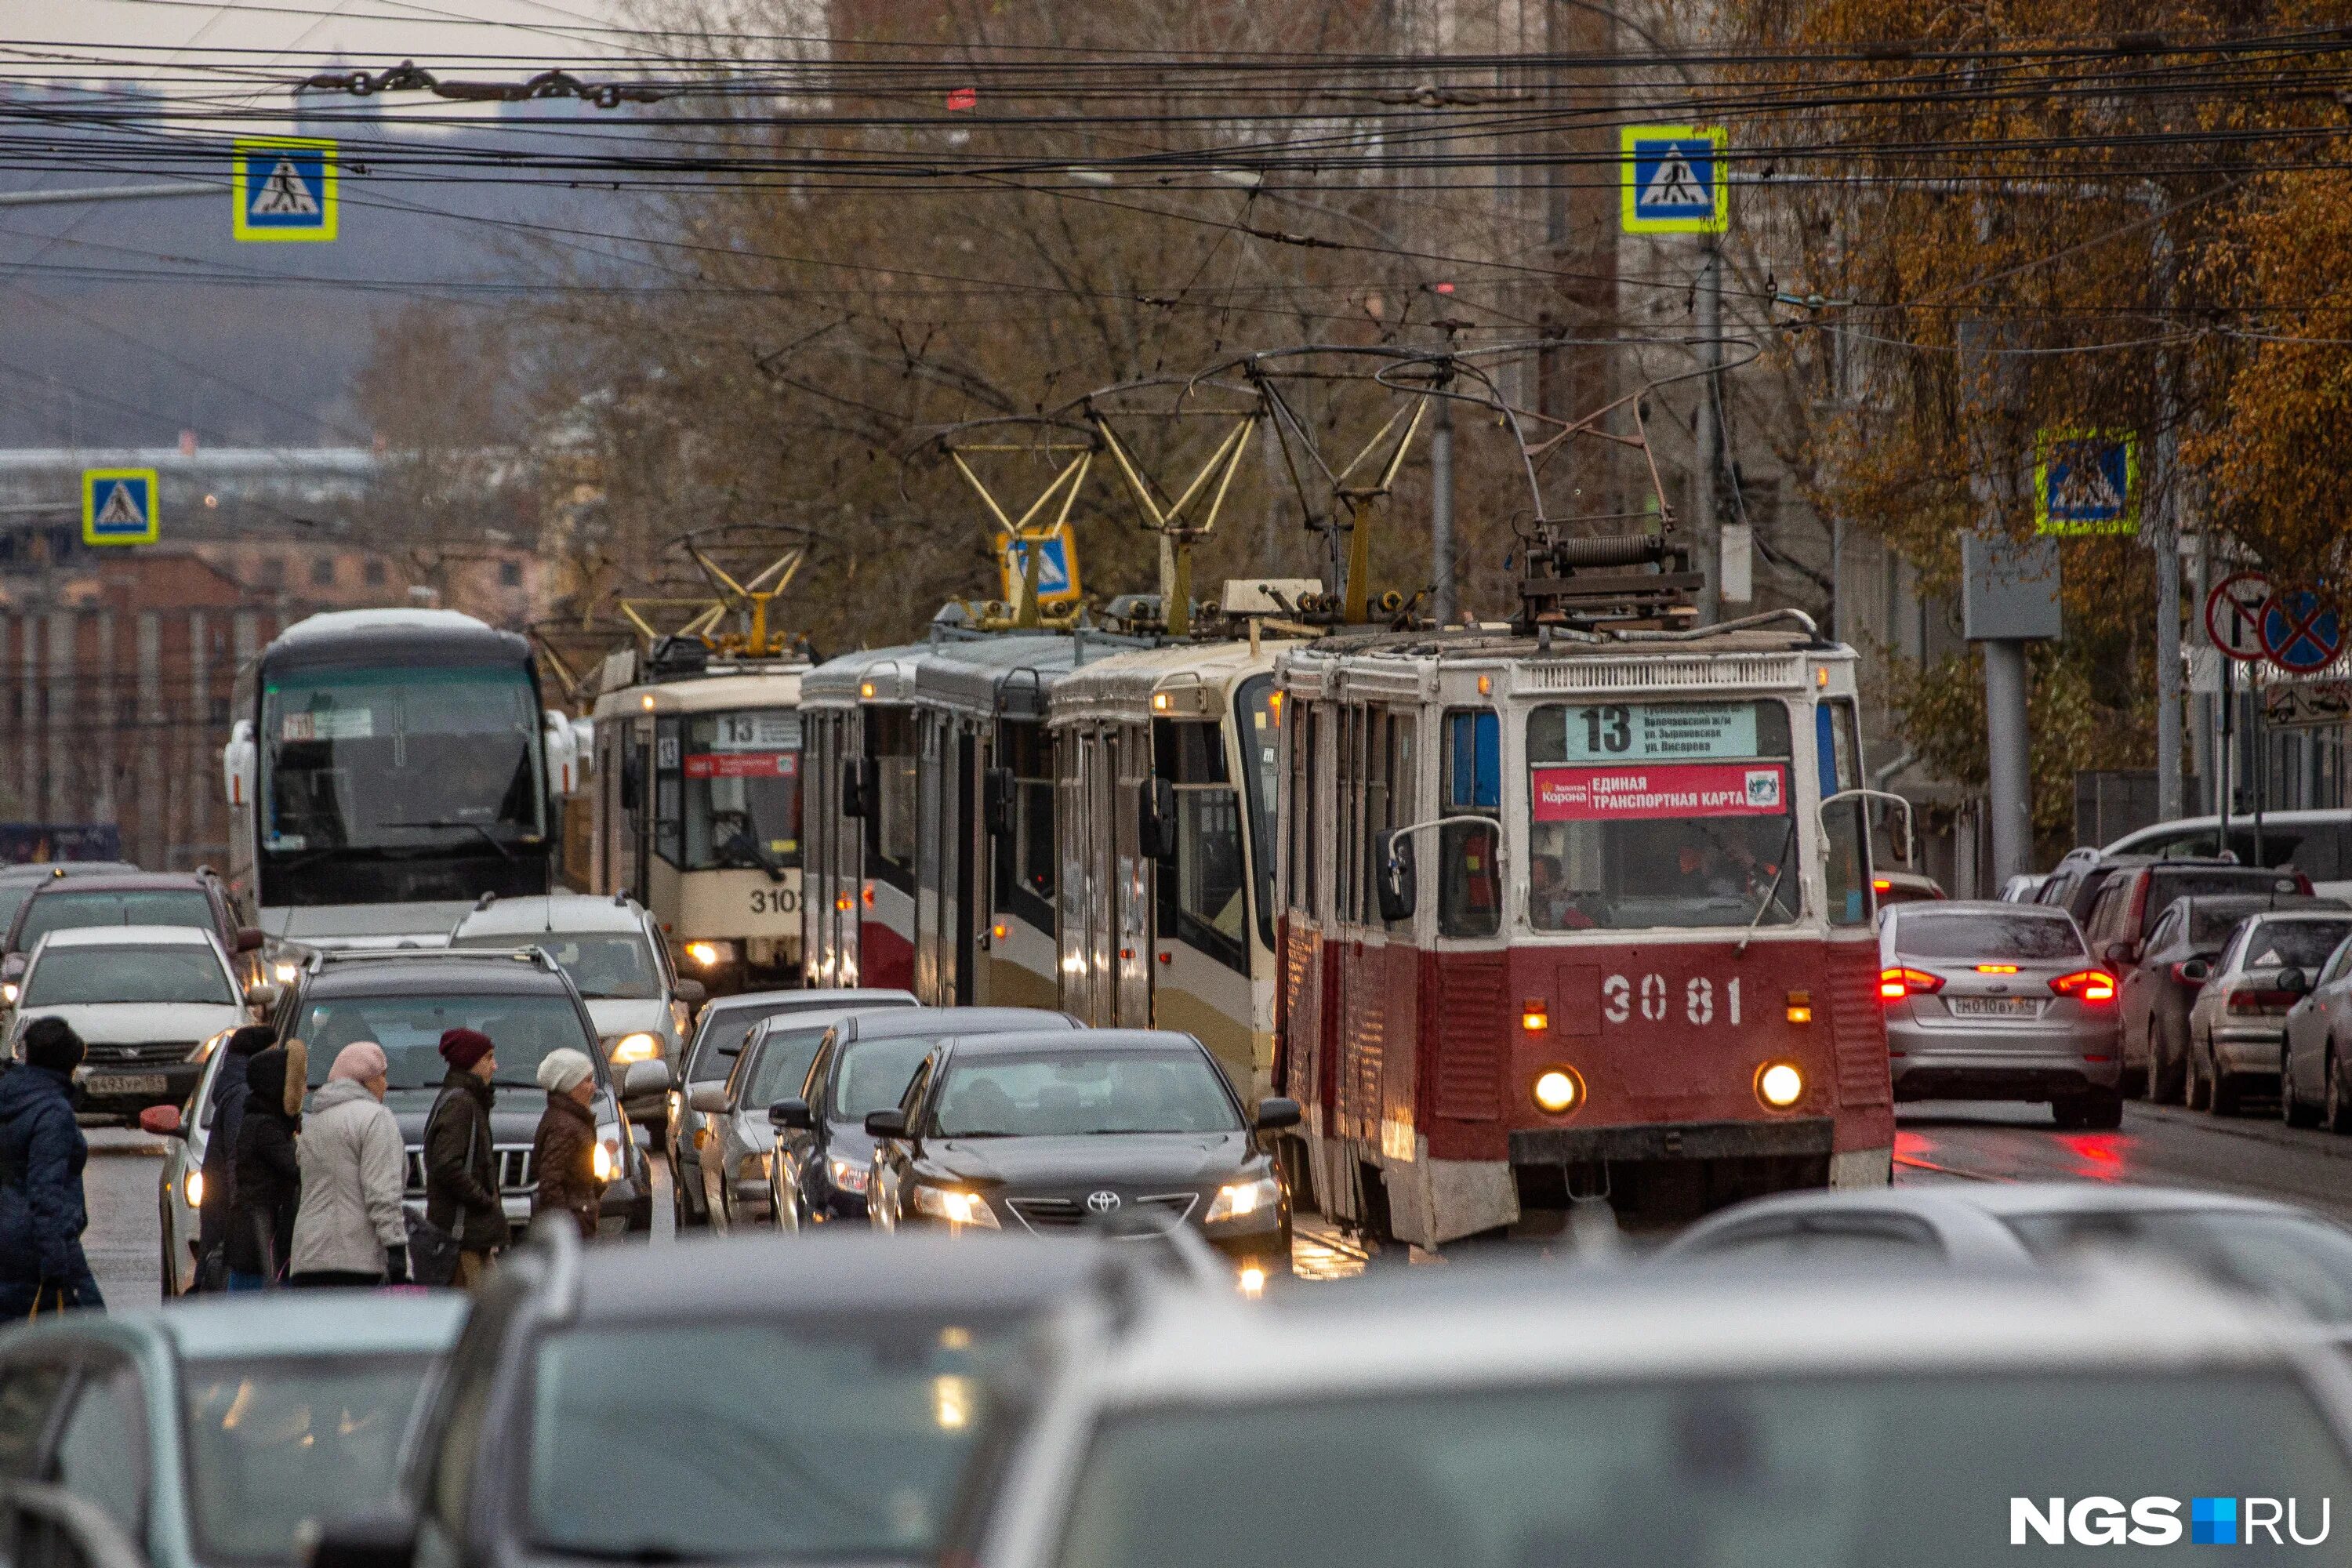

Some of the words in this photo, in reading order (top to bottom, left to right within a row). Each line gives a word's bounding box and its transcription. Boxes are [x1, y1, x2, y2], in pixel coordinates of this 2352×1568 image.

[727, 715, 754, 742] 13
[1579, 705, 1632, 753] 13
[1645, 742, 1659, 753] ул.
[1661, 742, 1711, 752] Писарева
[1592, 776, 1646, 793] ЕДИНАЯ
[1542, 791, 1587, 804] Корона
[1592, 792, 1697, 809] ТРАНСПОРТНАЯ
[1701, 791, 1745, 806] КАРТА
[750, 888, 803, 914] 310
[1603, 973, 1740, 1026] 3081
